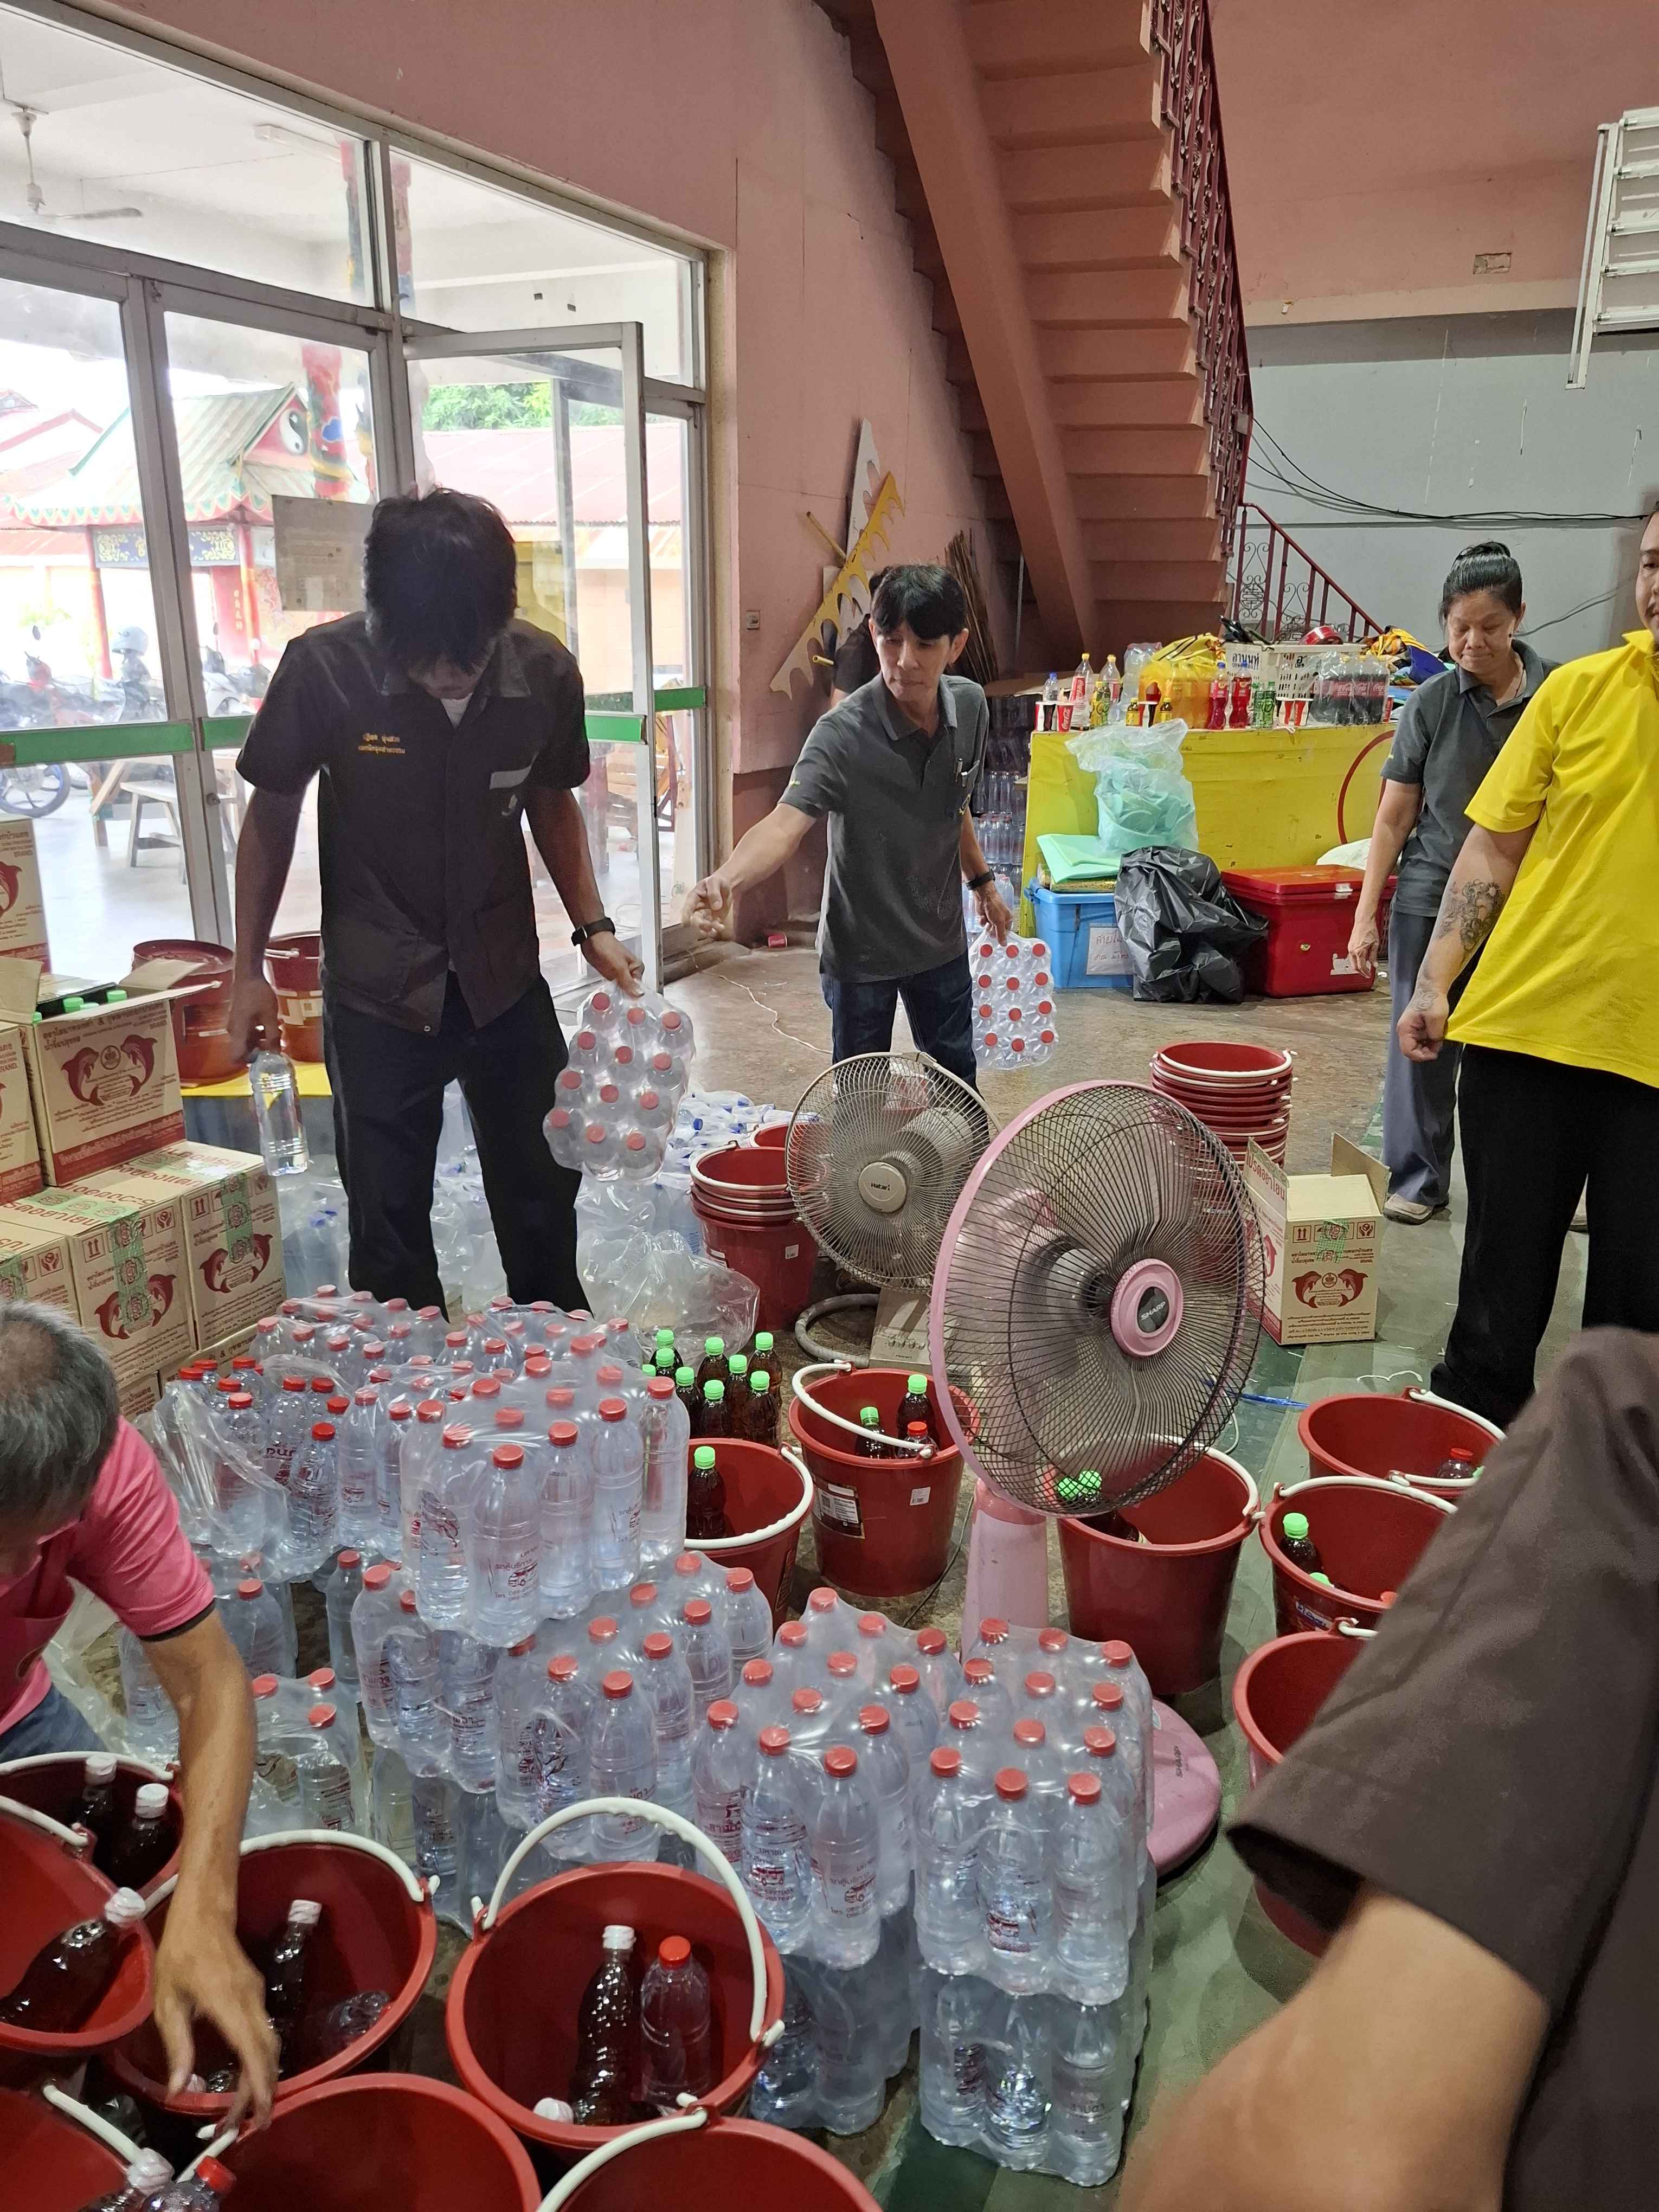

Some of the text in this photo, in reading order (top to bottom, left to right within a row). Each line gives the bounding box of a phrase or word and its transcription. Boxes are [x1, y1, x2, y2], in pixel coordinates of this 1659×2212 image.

[1061, 709, 1071, 730] Coca-Cola
[871, 1182, 890, 1191] Hatari
[1141, 1301, 1166, 1320] SHARP
